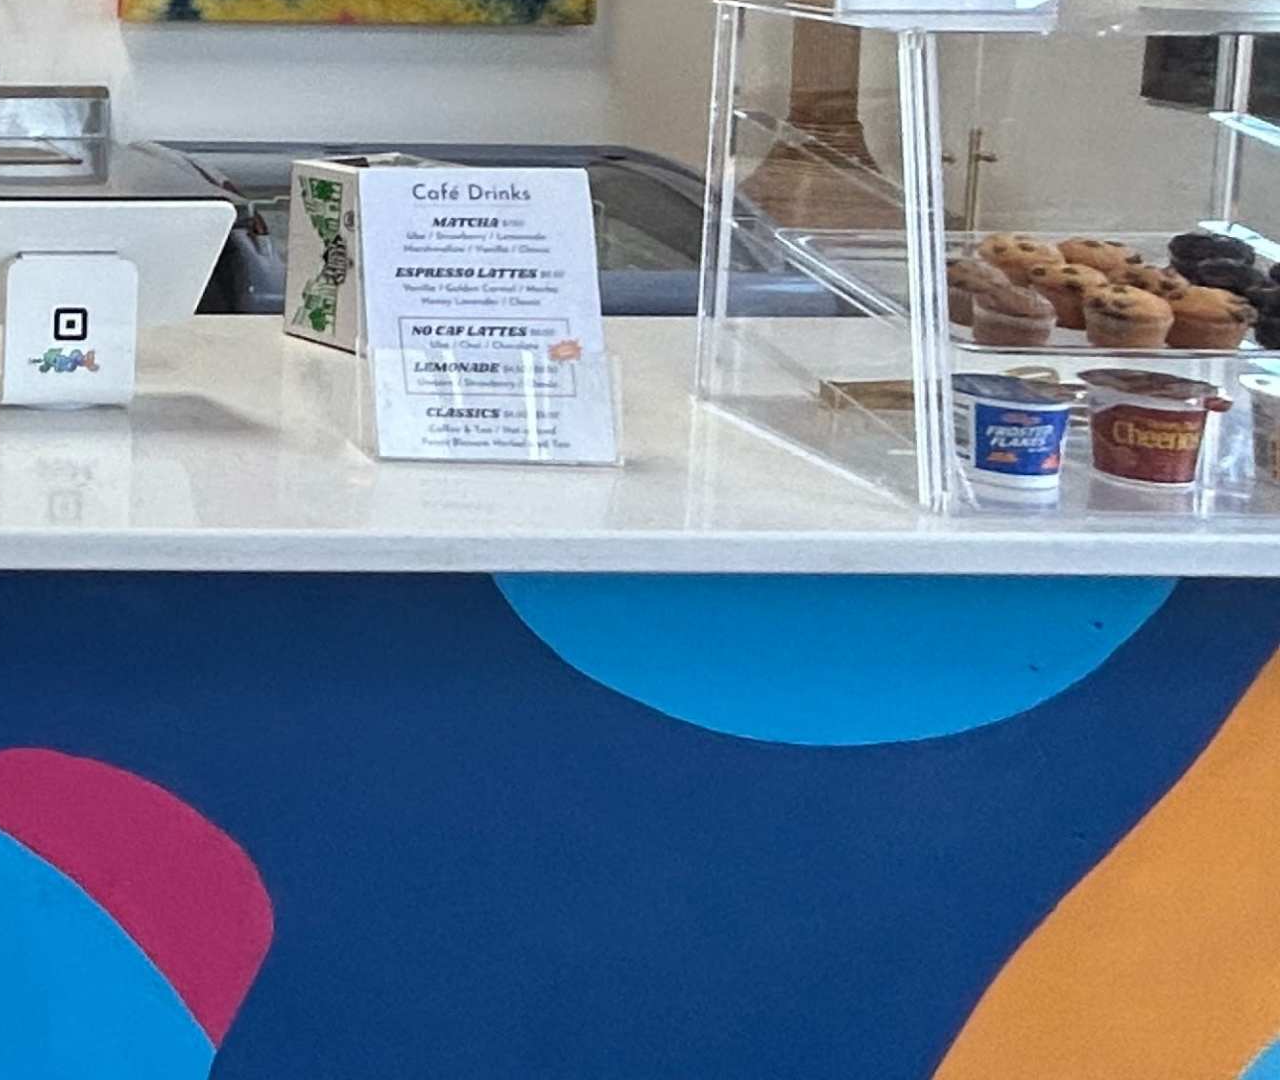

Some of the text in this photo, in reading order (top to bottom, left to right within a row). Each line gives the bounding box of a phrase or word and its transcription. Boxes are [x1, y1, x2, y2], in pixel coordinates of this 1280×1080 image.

[412, 182, 531, 201] Café Drinks
[432, 217, 499, 228] MATCHA
[395, 267, 474, 278] ESPRESSO
[477, 268, 537, 279] LATTES
[411, 325, 433, 336] NO
[435, 325, 465, 336] CAF
[467, 326, 528, 337] LATTES
[414, 362, 500, 373] LEMONADE
[426, 407, 501, 419] CLASSICS
